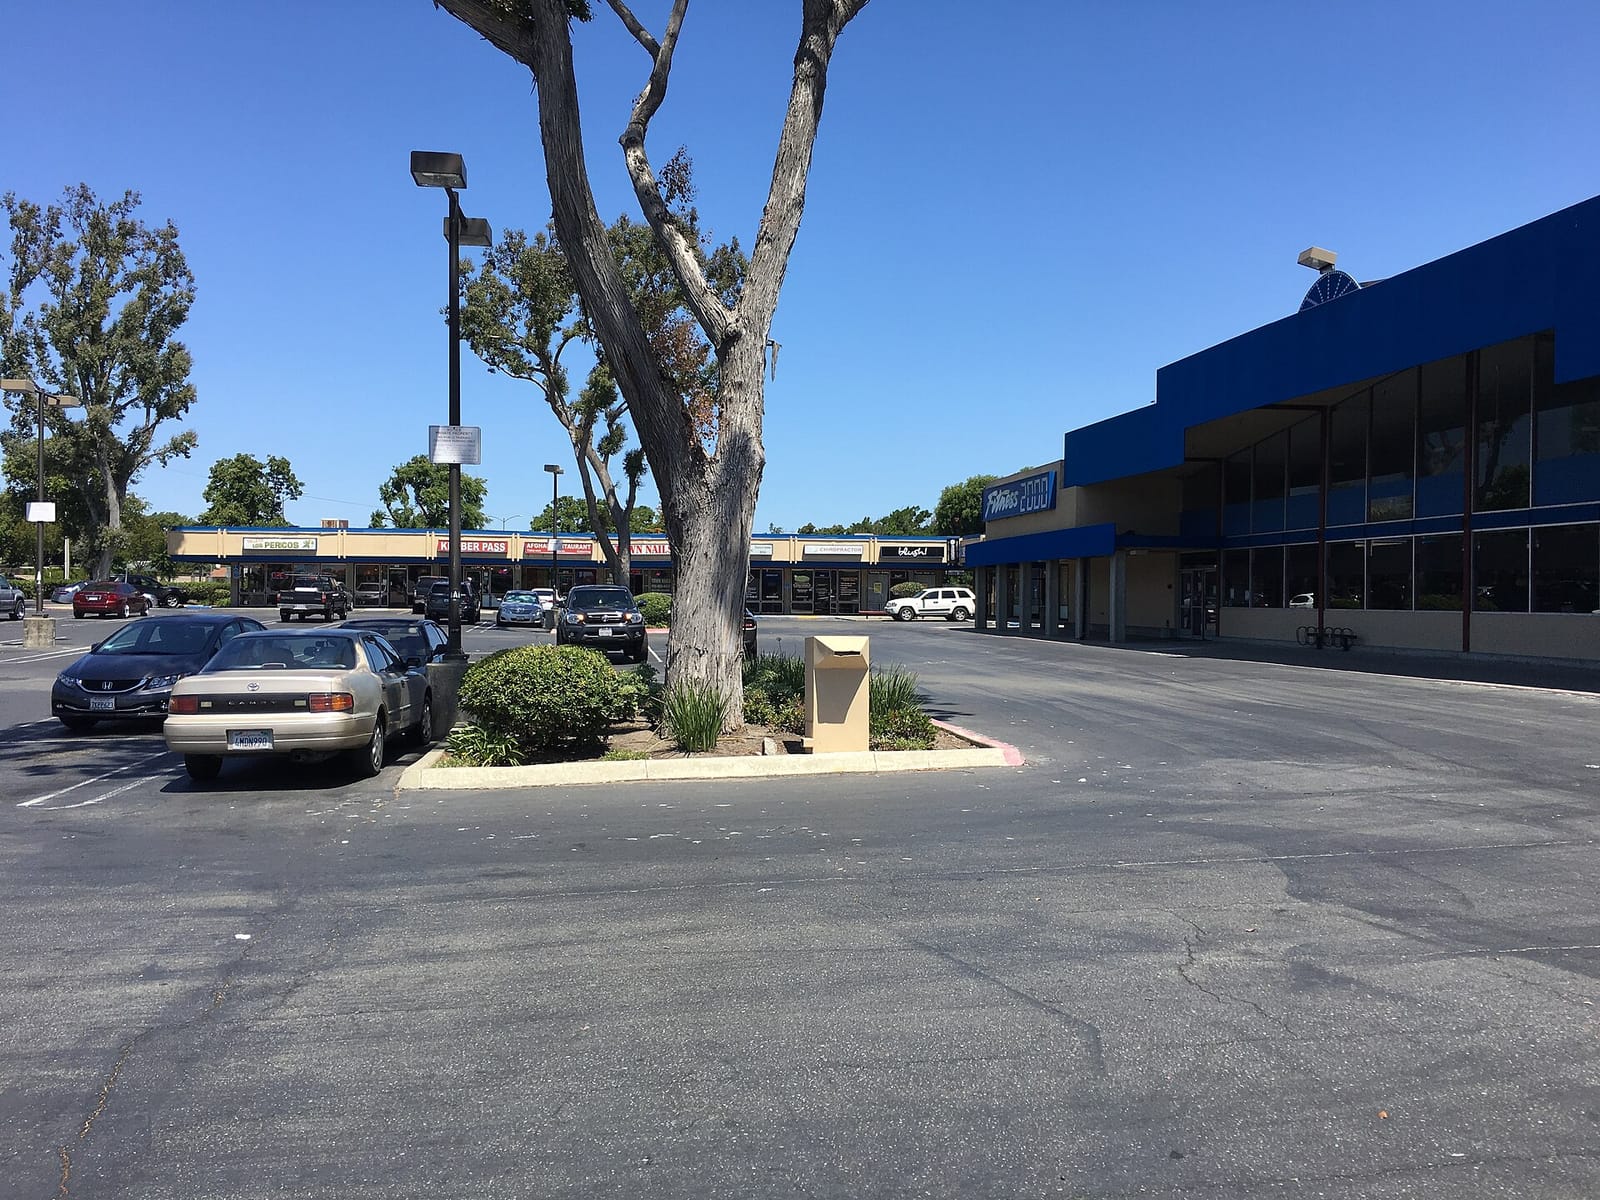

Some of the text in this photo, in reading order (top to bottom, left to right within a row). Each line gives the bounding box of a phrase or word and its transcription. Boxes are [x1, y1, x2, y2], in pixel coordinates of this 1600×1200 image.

[985, 477, 1048, 518] Fitness 2000
[440, 541, 506, 552] KBER PASS
